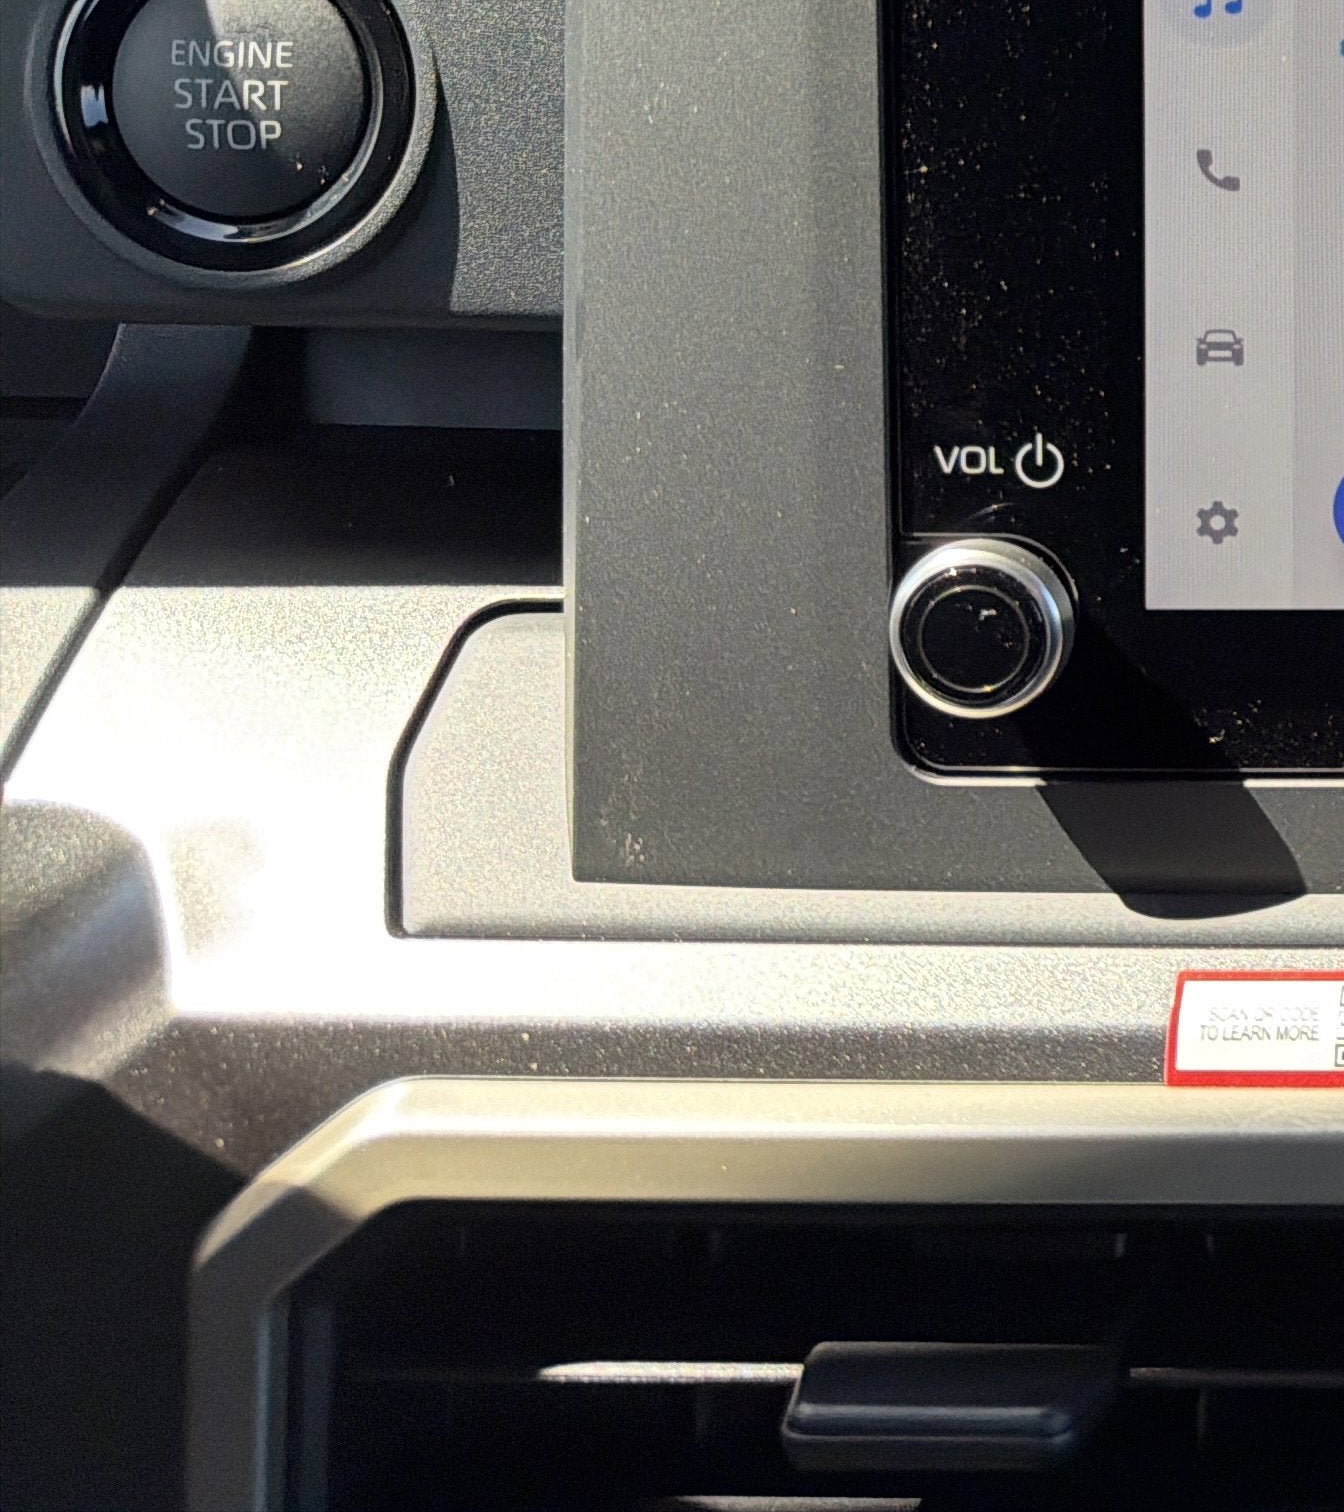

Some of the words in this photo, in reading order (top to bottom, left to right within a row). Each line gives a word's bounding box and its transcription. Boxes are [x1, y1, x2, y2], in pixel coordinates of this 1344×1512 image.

[170, 39, 294, 69] ENGINE
[174, 79, 289, 111] START
[185, 118, 282, 150] STOP
[934, 445, 1005, 475] VOL
[1200, 1024, 1219, 1041] TO
[1222, 1024, 1272, 1041] LEARN
[1276, 1024, 1320, 1041] MORE
